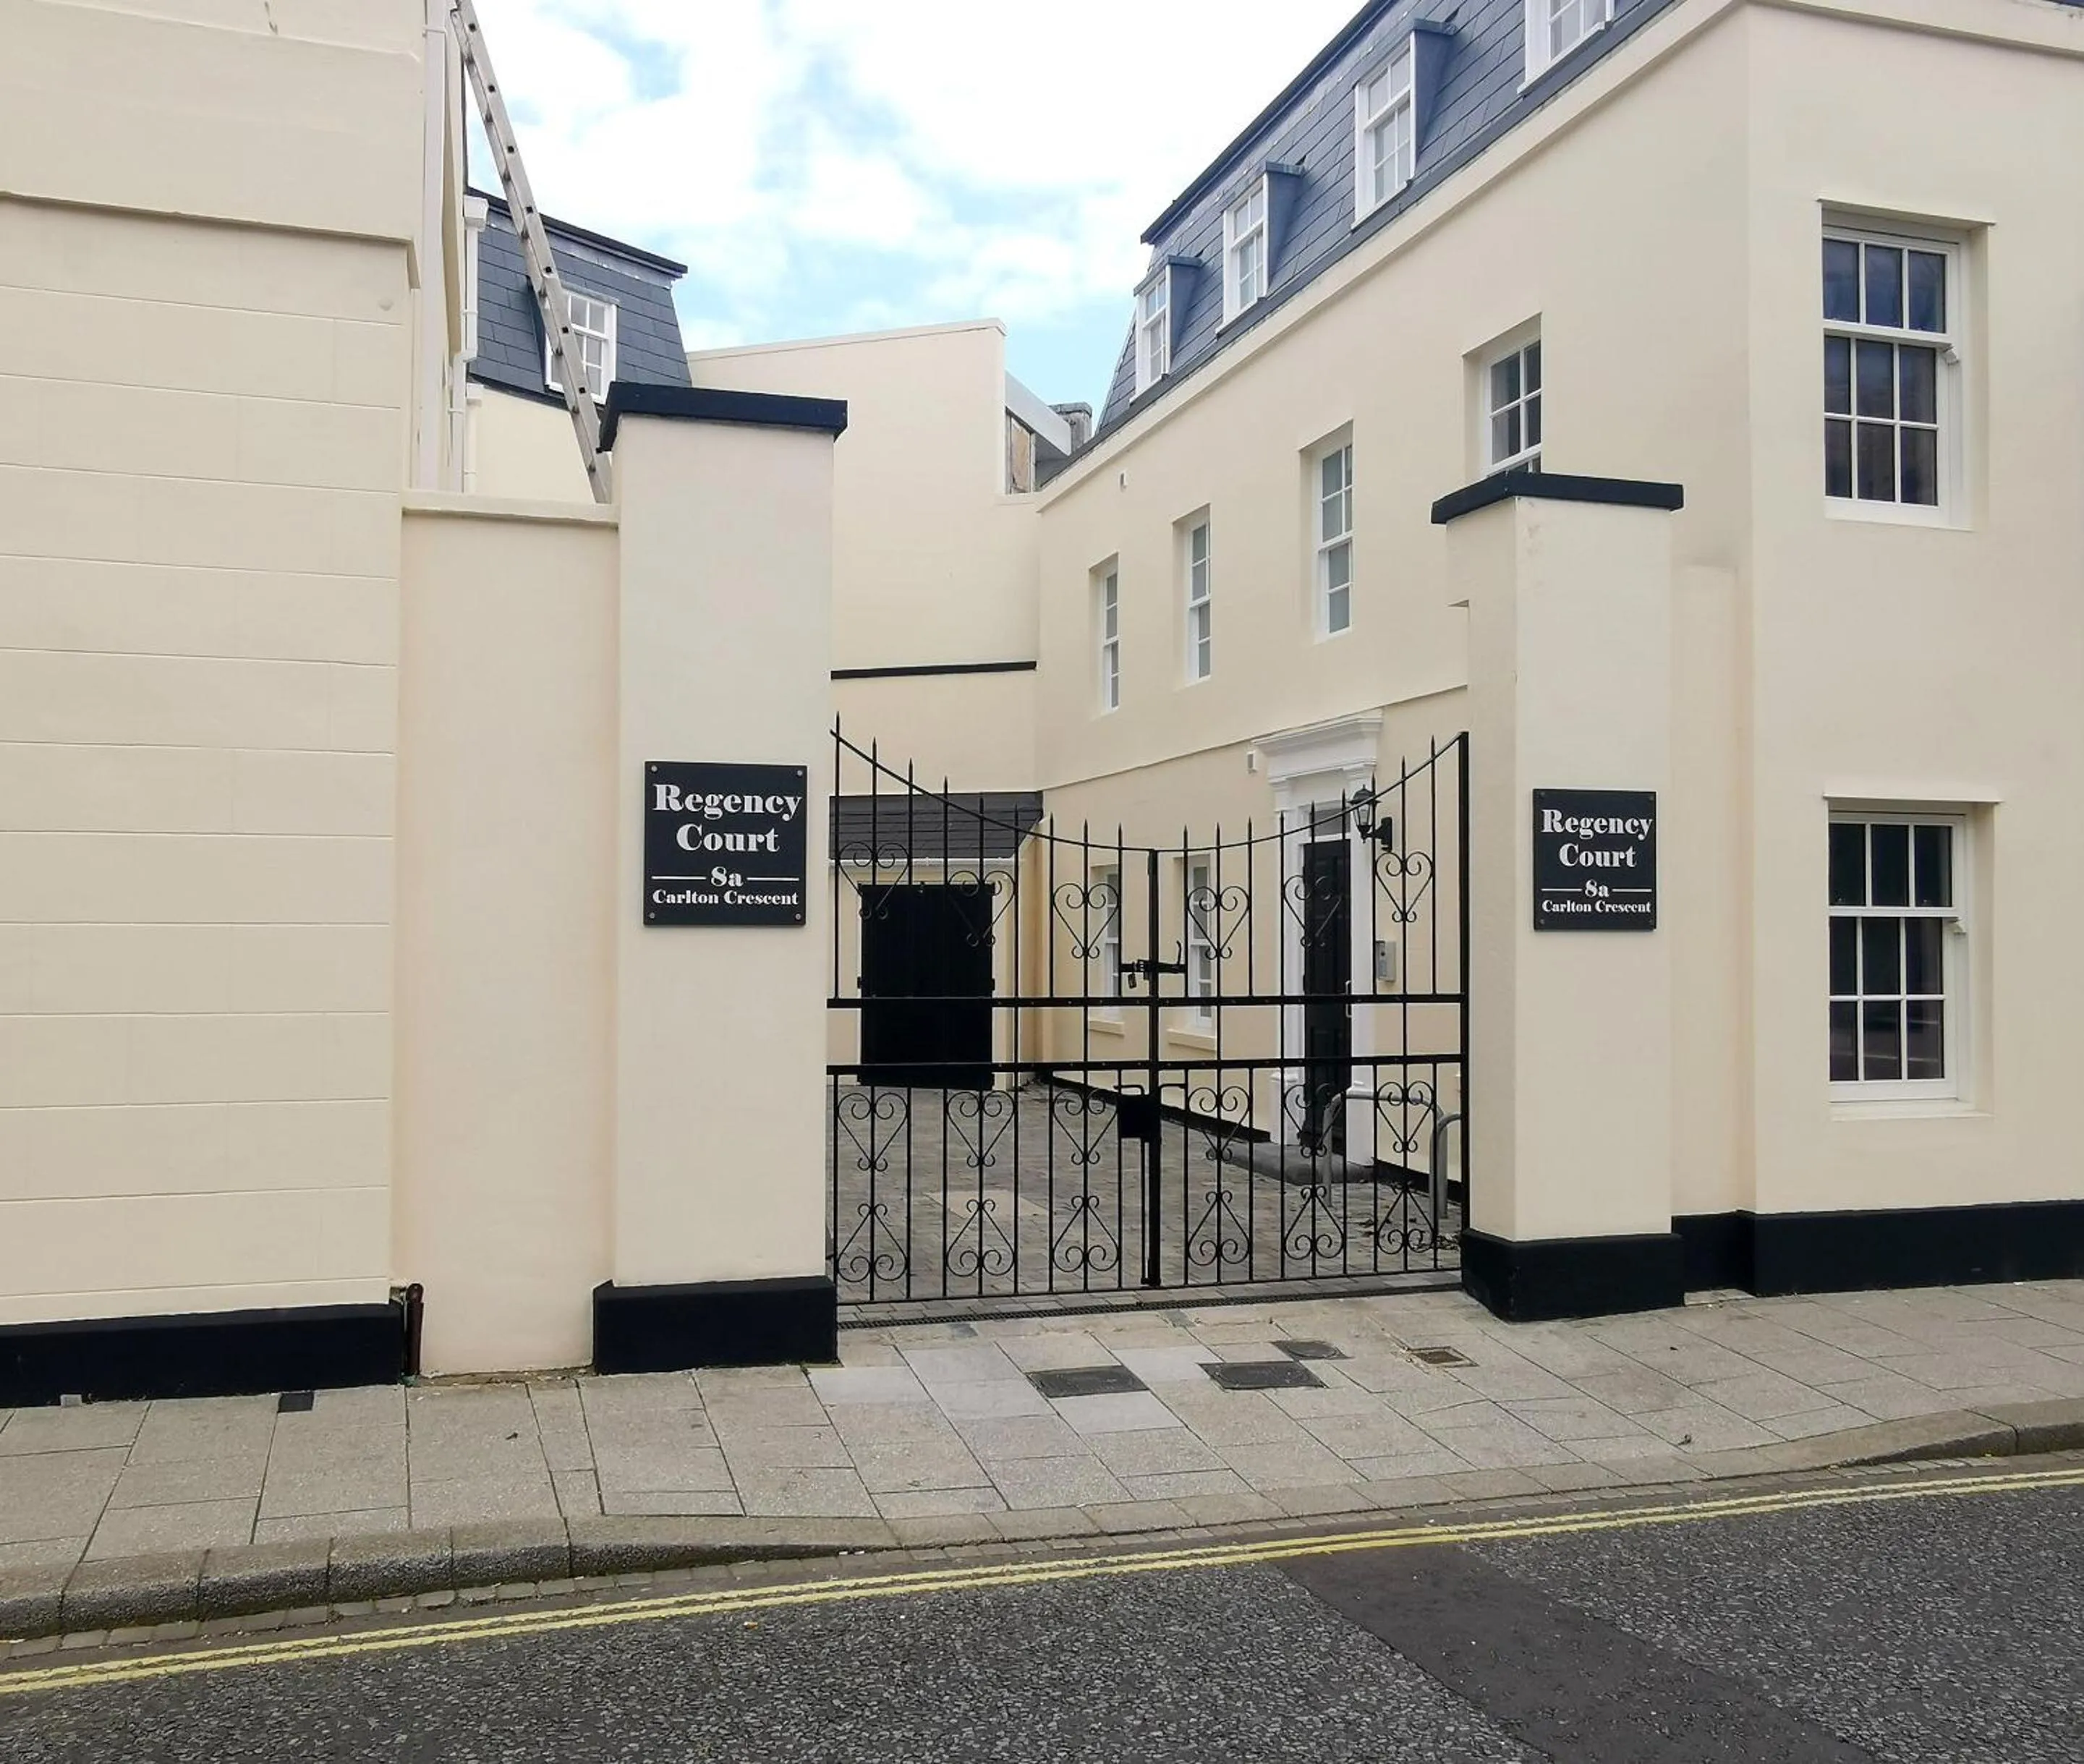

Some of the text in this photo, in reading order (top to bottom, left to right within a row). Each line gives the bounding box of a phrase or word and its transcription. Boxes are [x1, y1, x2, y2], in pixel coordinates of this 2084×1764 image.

[652, 784, 802, 821] Regency
[1541, 809, 1653, 840] Regency
[676, 823, 781, 852] Court
[1559, 843, 1637, 867] Court
[710, 866, 744, 887] 8a
[652, 890, 799, 905] Carlton Crescent
[1584, 879, 1609, 898] 8a
[1541, 900, 1651, 913] Carlton Crescent
